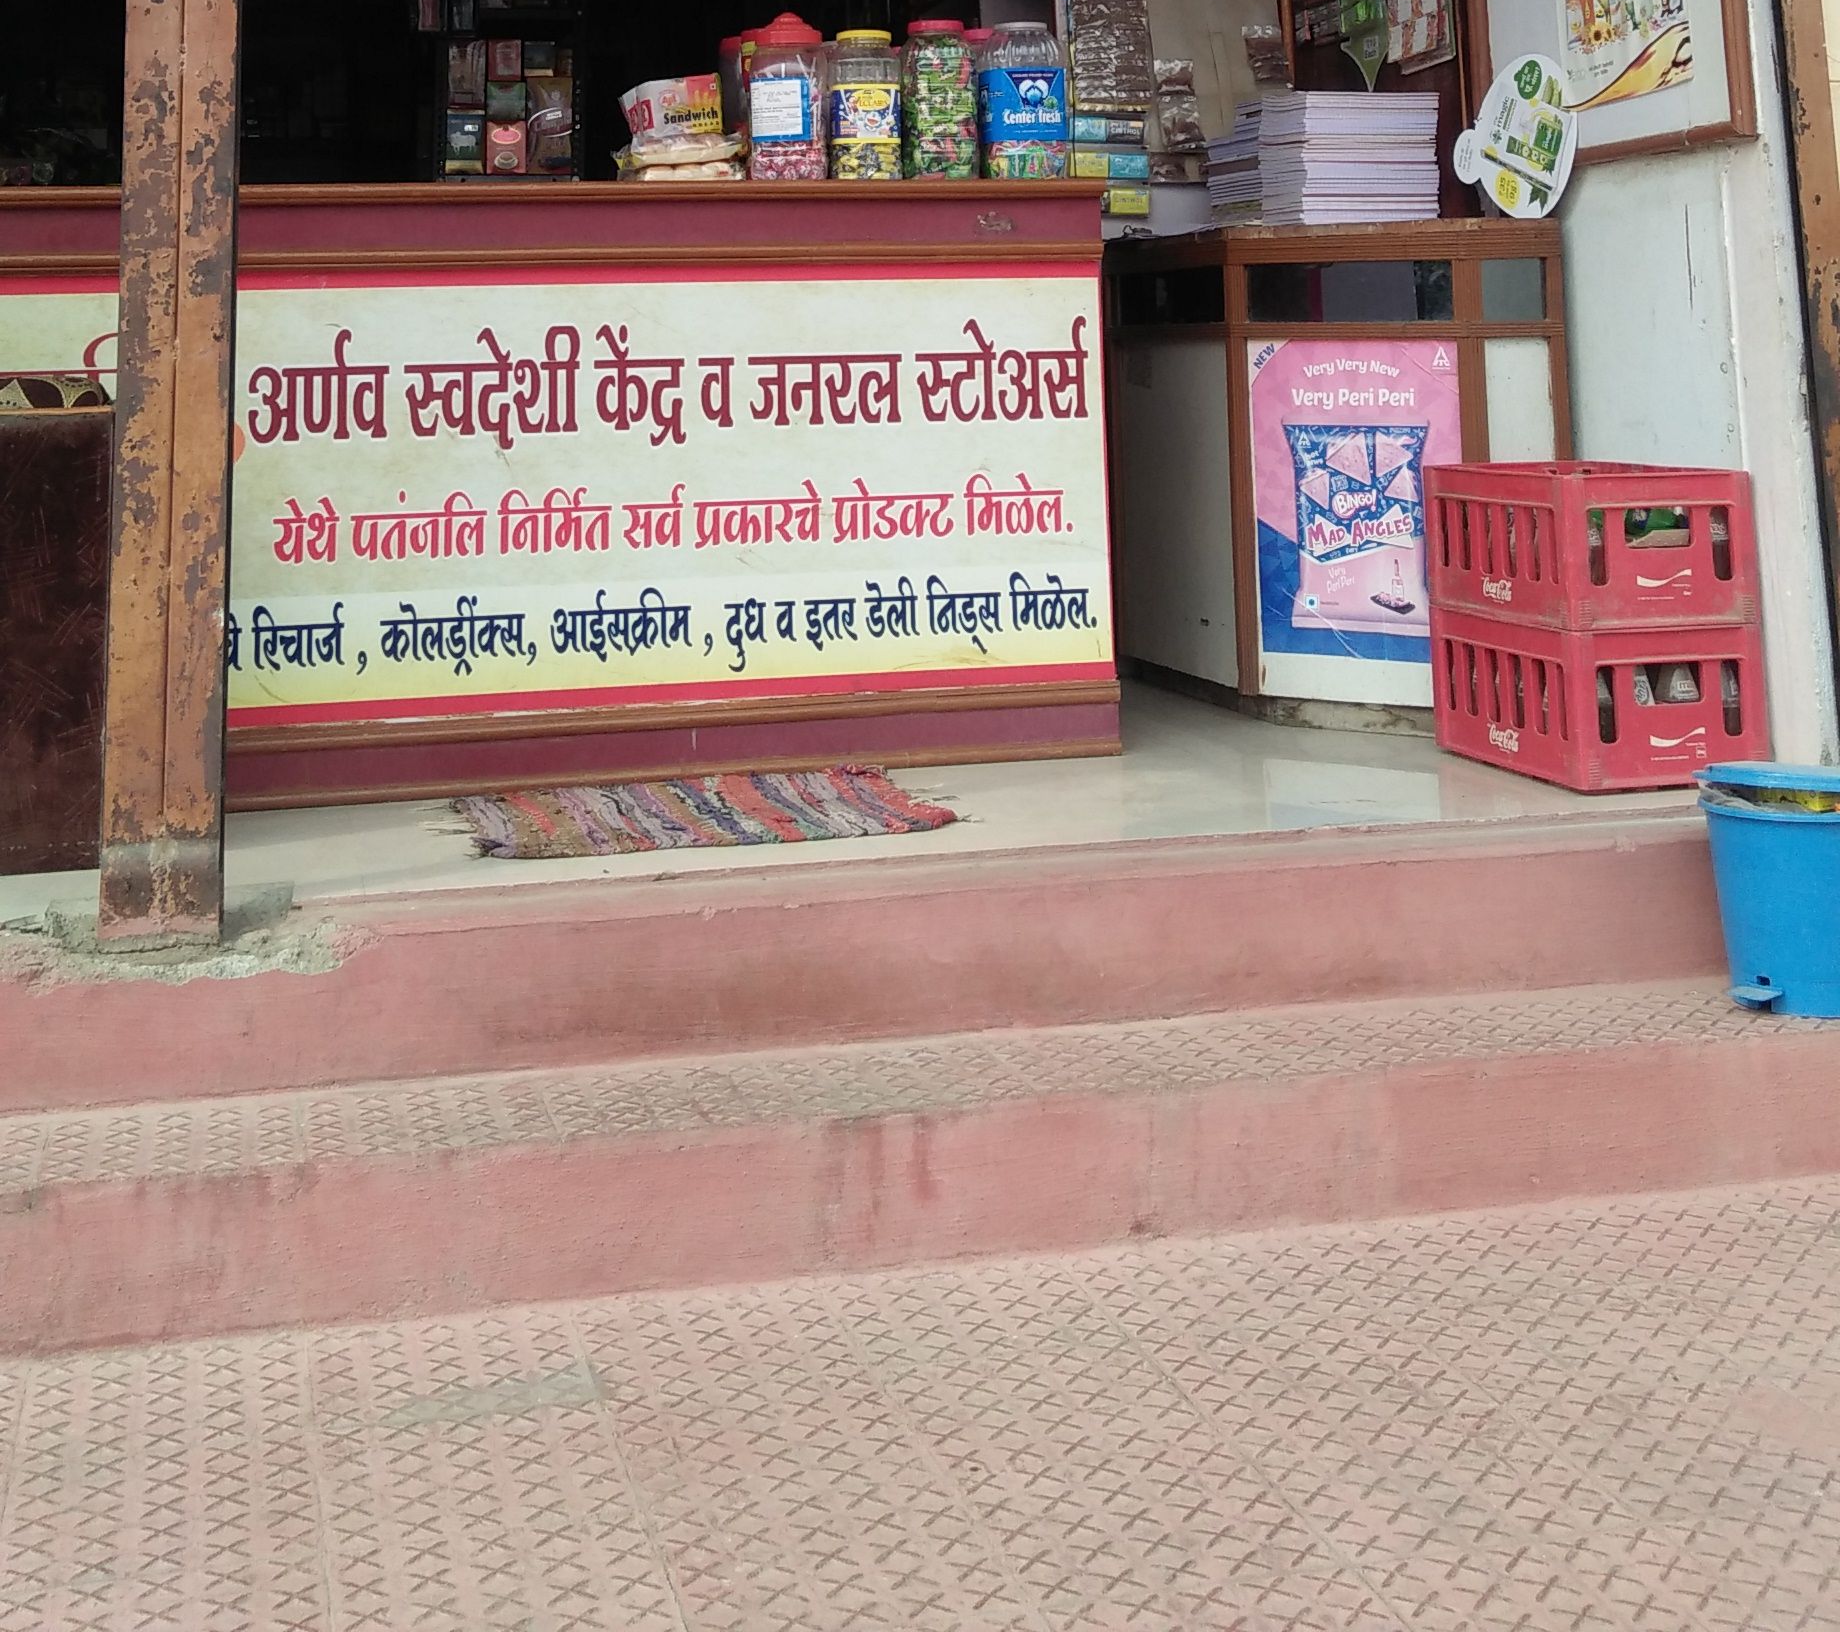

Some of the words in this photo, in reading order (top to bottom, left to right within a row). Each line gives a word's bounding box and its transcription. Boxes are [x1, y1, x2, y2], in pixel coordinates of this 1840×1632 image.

[663, 107, 719, 125] Sandwich
[1003, 108, 1036, 125] Center
[1038, 109, 1062, 124] fresh
[1252, 342, 1276, 370] NEW
[1303, 363, 1335, 379] Very
[1336, 358, 1368, 374] Very
[1370, 360, 1400, 378] New
[247, 328, 390, 445] अर्णव
[403, 325, 581, 450] स्वदेशी
[593, 323, 688, 447] केंद्र
[698, 356, 735, 428] व
[747, 353, 902, 427] जनरल
[914, 316, 1090, 422] स्टोअर्स
[1291, 387, 1335, 410] Very
[1338, 387, 1374, 407] Peri
[1378, 387, 1415, 407] Peri
[1335, 488, 1377, 515] BINGO!
[272, 496, 341, 564] येथे
[349, 489, 488, 561] पतंजलि
[497, 486, 613, 555] निर्मित
[621, 483, 686, 549] सर्व
[692, 479, 823, 549] प्रकारचे
[831, 477, 954, 545] प्रोडक्ट
[963, 472, 1074, 537] मिळेल.
[1307, 521, 1346, 549] MAD
[1351, 513, 1414, 546] ANGLES
[723, 597, 769, 673] दुध
[775, 600, 796, 642] व
[804, 597, 858, 652] इतर
[864, 575, 921, 639] डेली
[926, 574, 1004, 655] निड्स
[1008, 571, 1098, 636] मिळेल.
